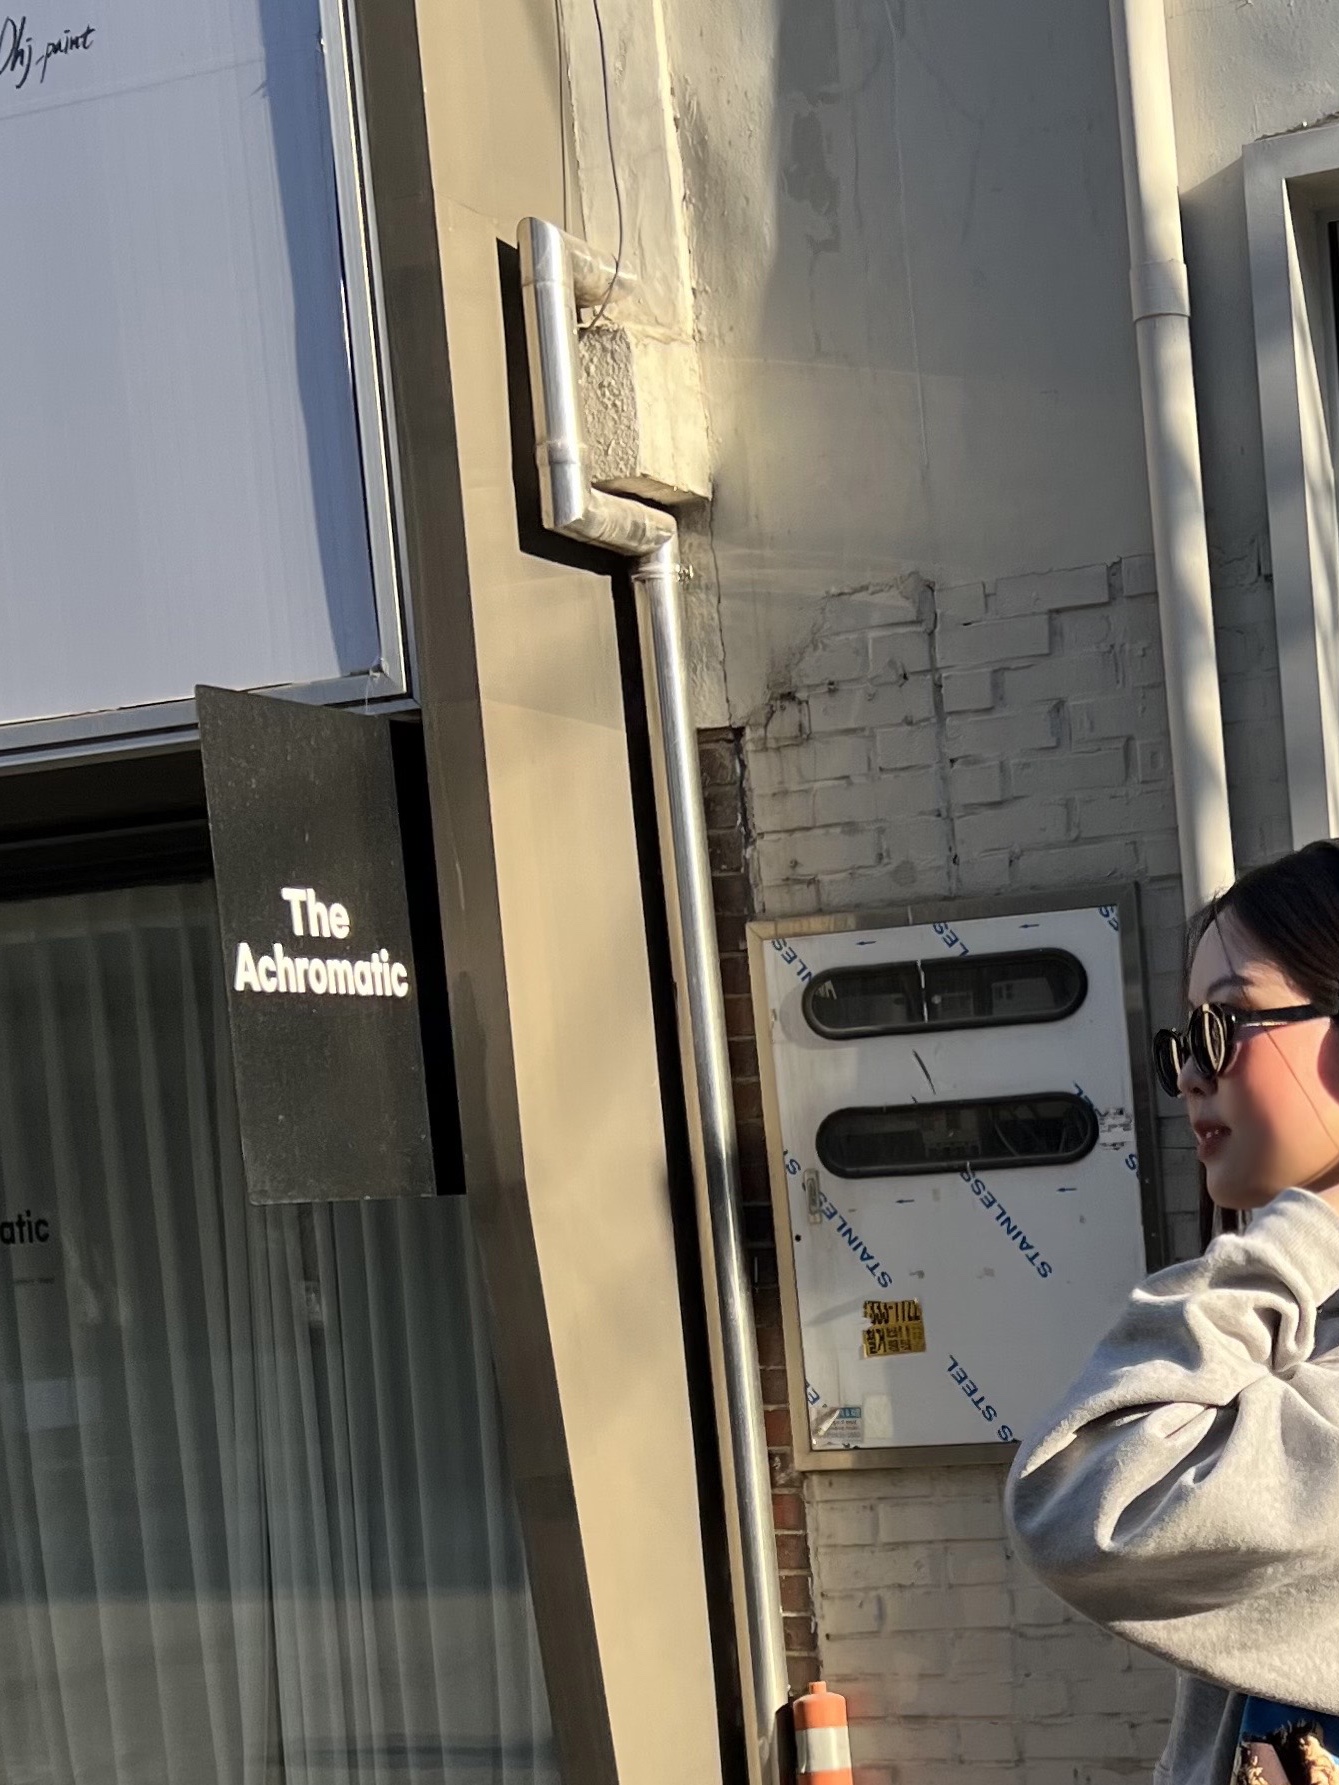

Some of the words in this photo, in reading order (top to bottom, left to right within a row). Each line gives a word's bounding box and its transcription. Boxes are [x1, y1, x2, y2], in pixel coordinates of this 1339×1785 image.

[281, 887, 351, 940] The
[234, 941, 410, 998] Achromatic
[0, 1209, 51, 1245] atic
[946, 1353, 998, 1422] STEEL
